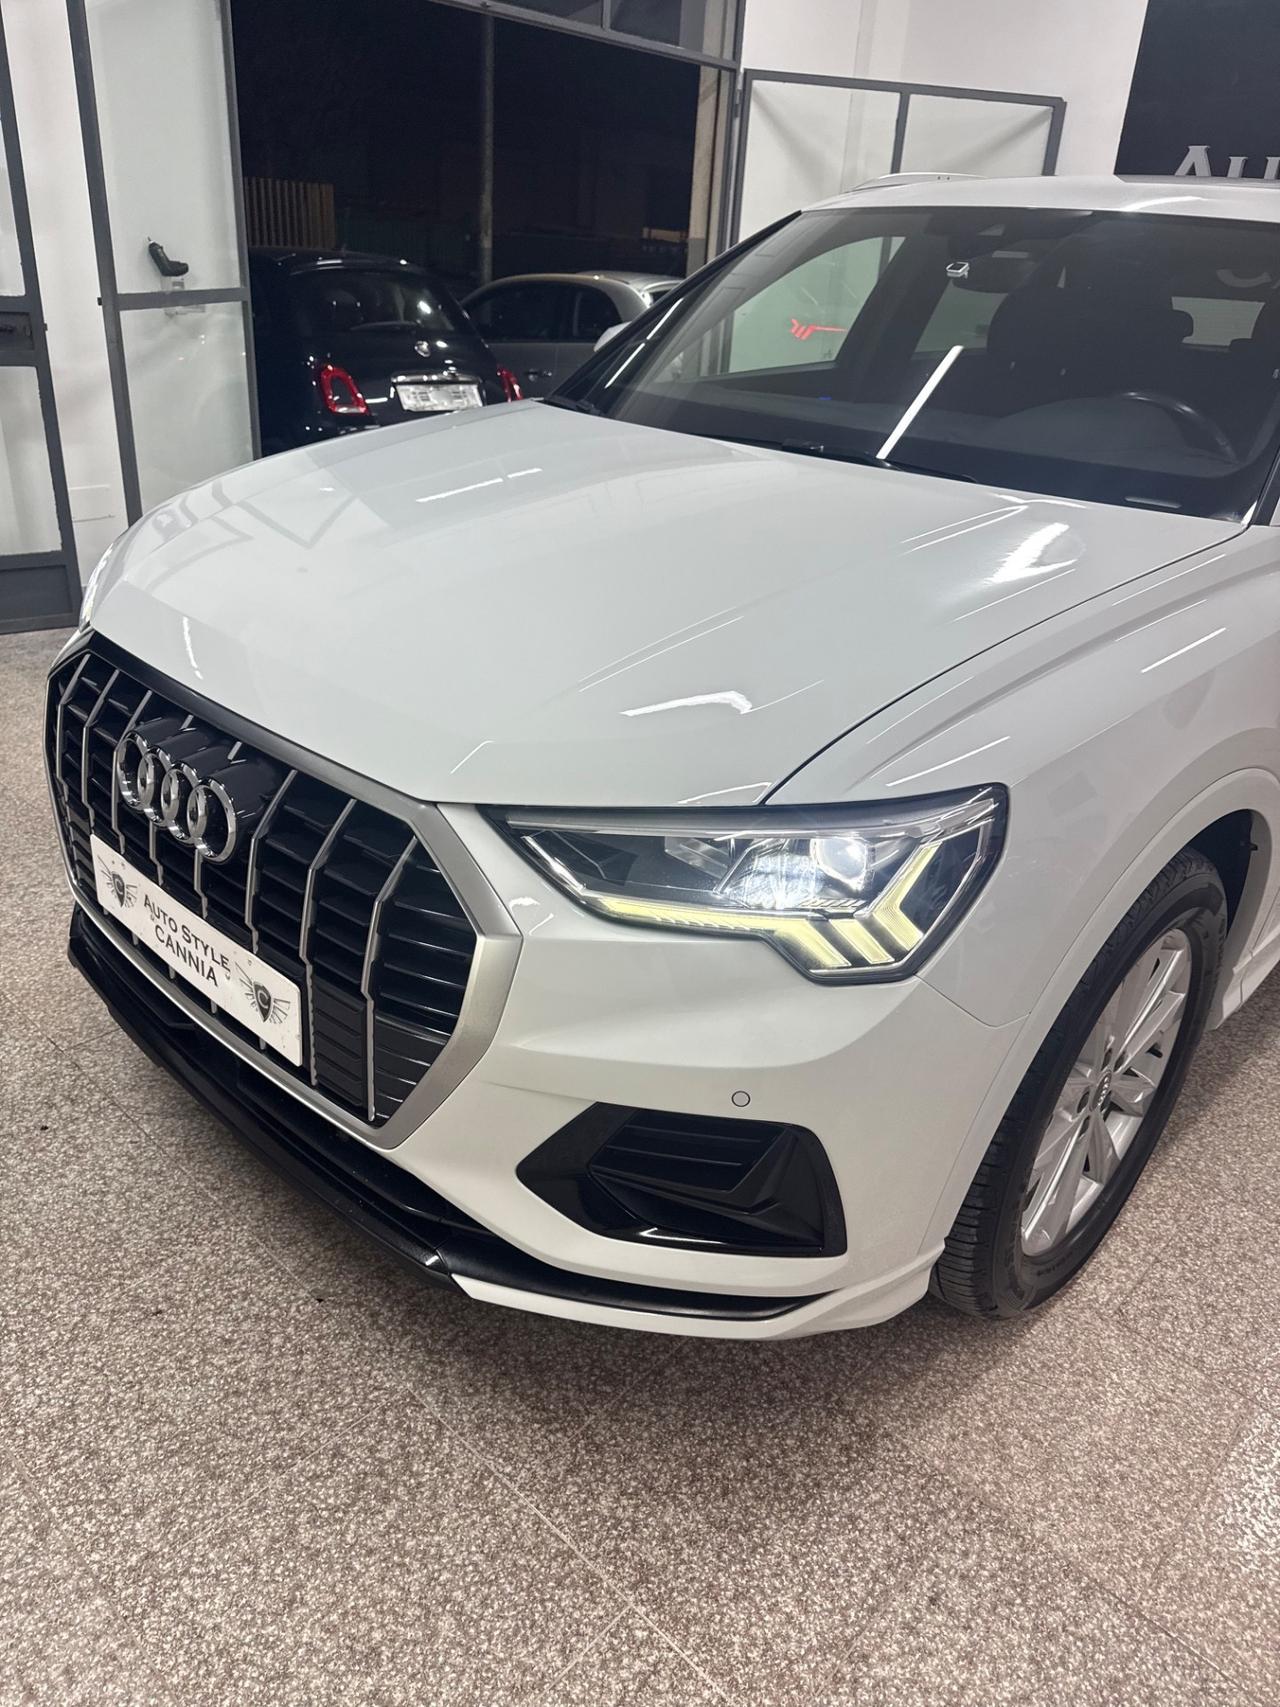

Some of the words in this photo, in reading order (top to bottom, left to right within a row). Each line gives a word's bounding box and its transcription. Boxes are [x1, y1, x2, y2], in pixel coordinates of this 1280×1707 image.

[143, 894, 178, 934] AUTO
[181, 924, 231, 973] STYLE
[155, 924, 218, 988] CANNIA
